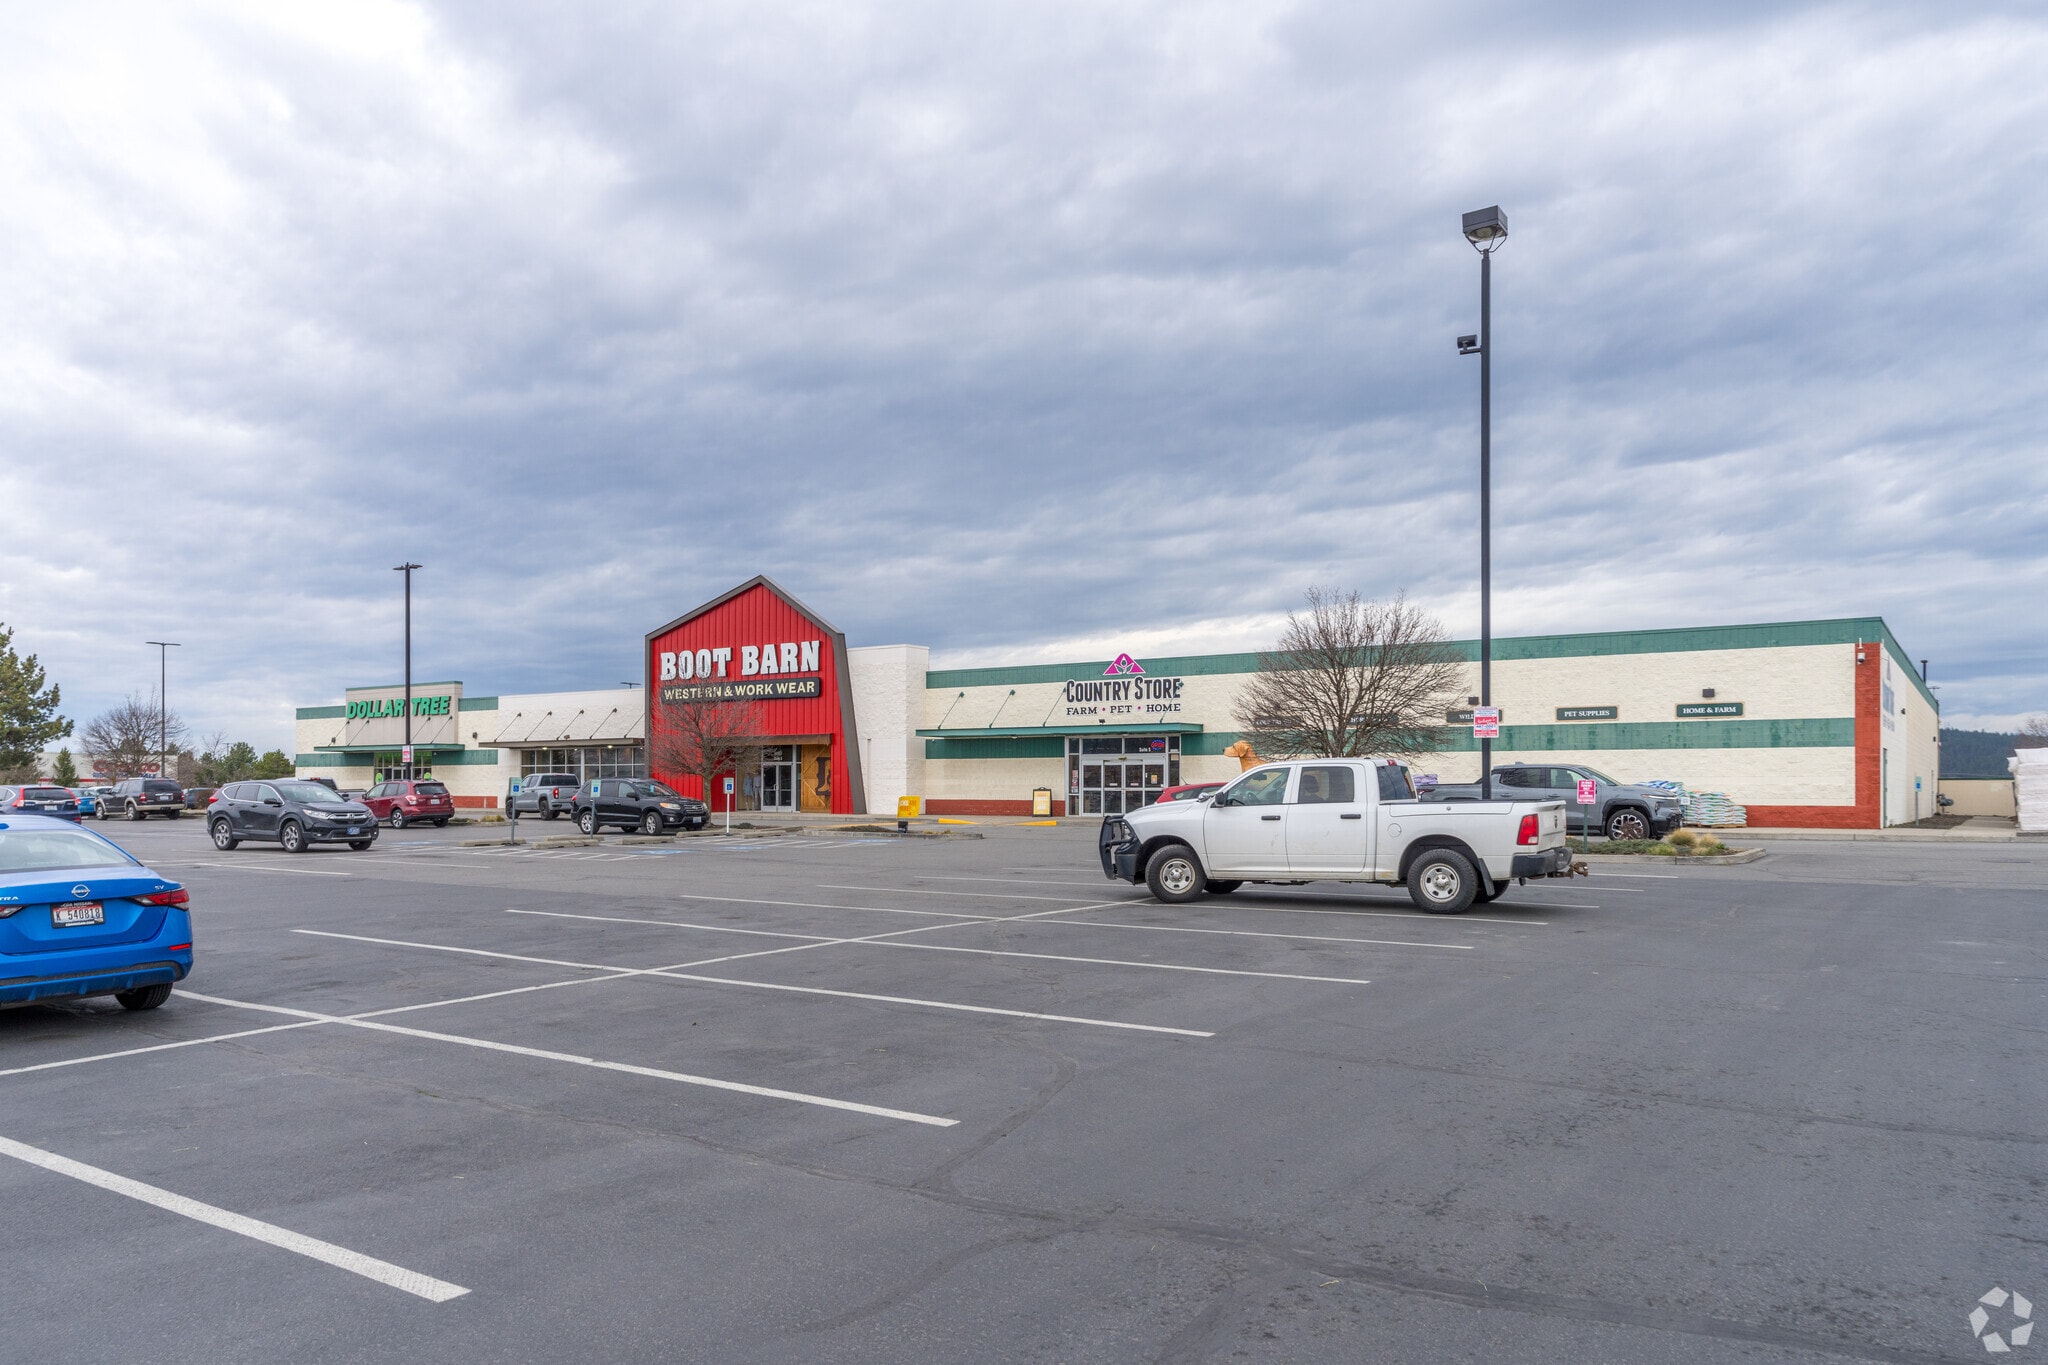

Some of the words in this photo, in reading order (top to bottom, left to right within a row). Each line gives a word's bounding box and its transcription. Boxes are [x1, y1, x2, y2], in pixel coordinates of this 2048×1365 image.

[660, 647, 732, 681] BOOT
[741, 640, 820, 676] BARN
[664, 686, 722, 700] WESTERN
[724, 685, 733, 697] &
[734, 683, 773, 697] WORK
[776, 681, 815, 694] WEAR
[1066, 680, 1131, 703] COUNTRY
[1134, 676, 1181, 700] STORE
[347, 699, 406, 719] DOLLAR
[411, 696, 452, 716] TREE
[1066, 706, 1098, 715] FARM
[1110, 704, 1132, 713] PET
[1146, 703, 1181, 712] HOME
[93, 760, 161, 773] CCO
[55, 911, 62, 921] K
[67, 908, 100, 920] 540818
